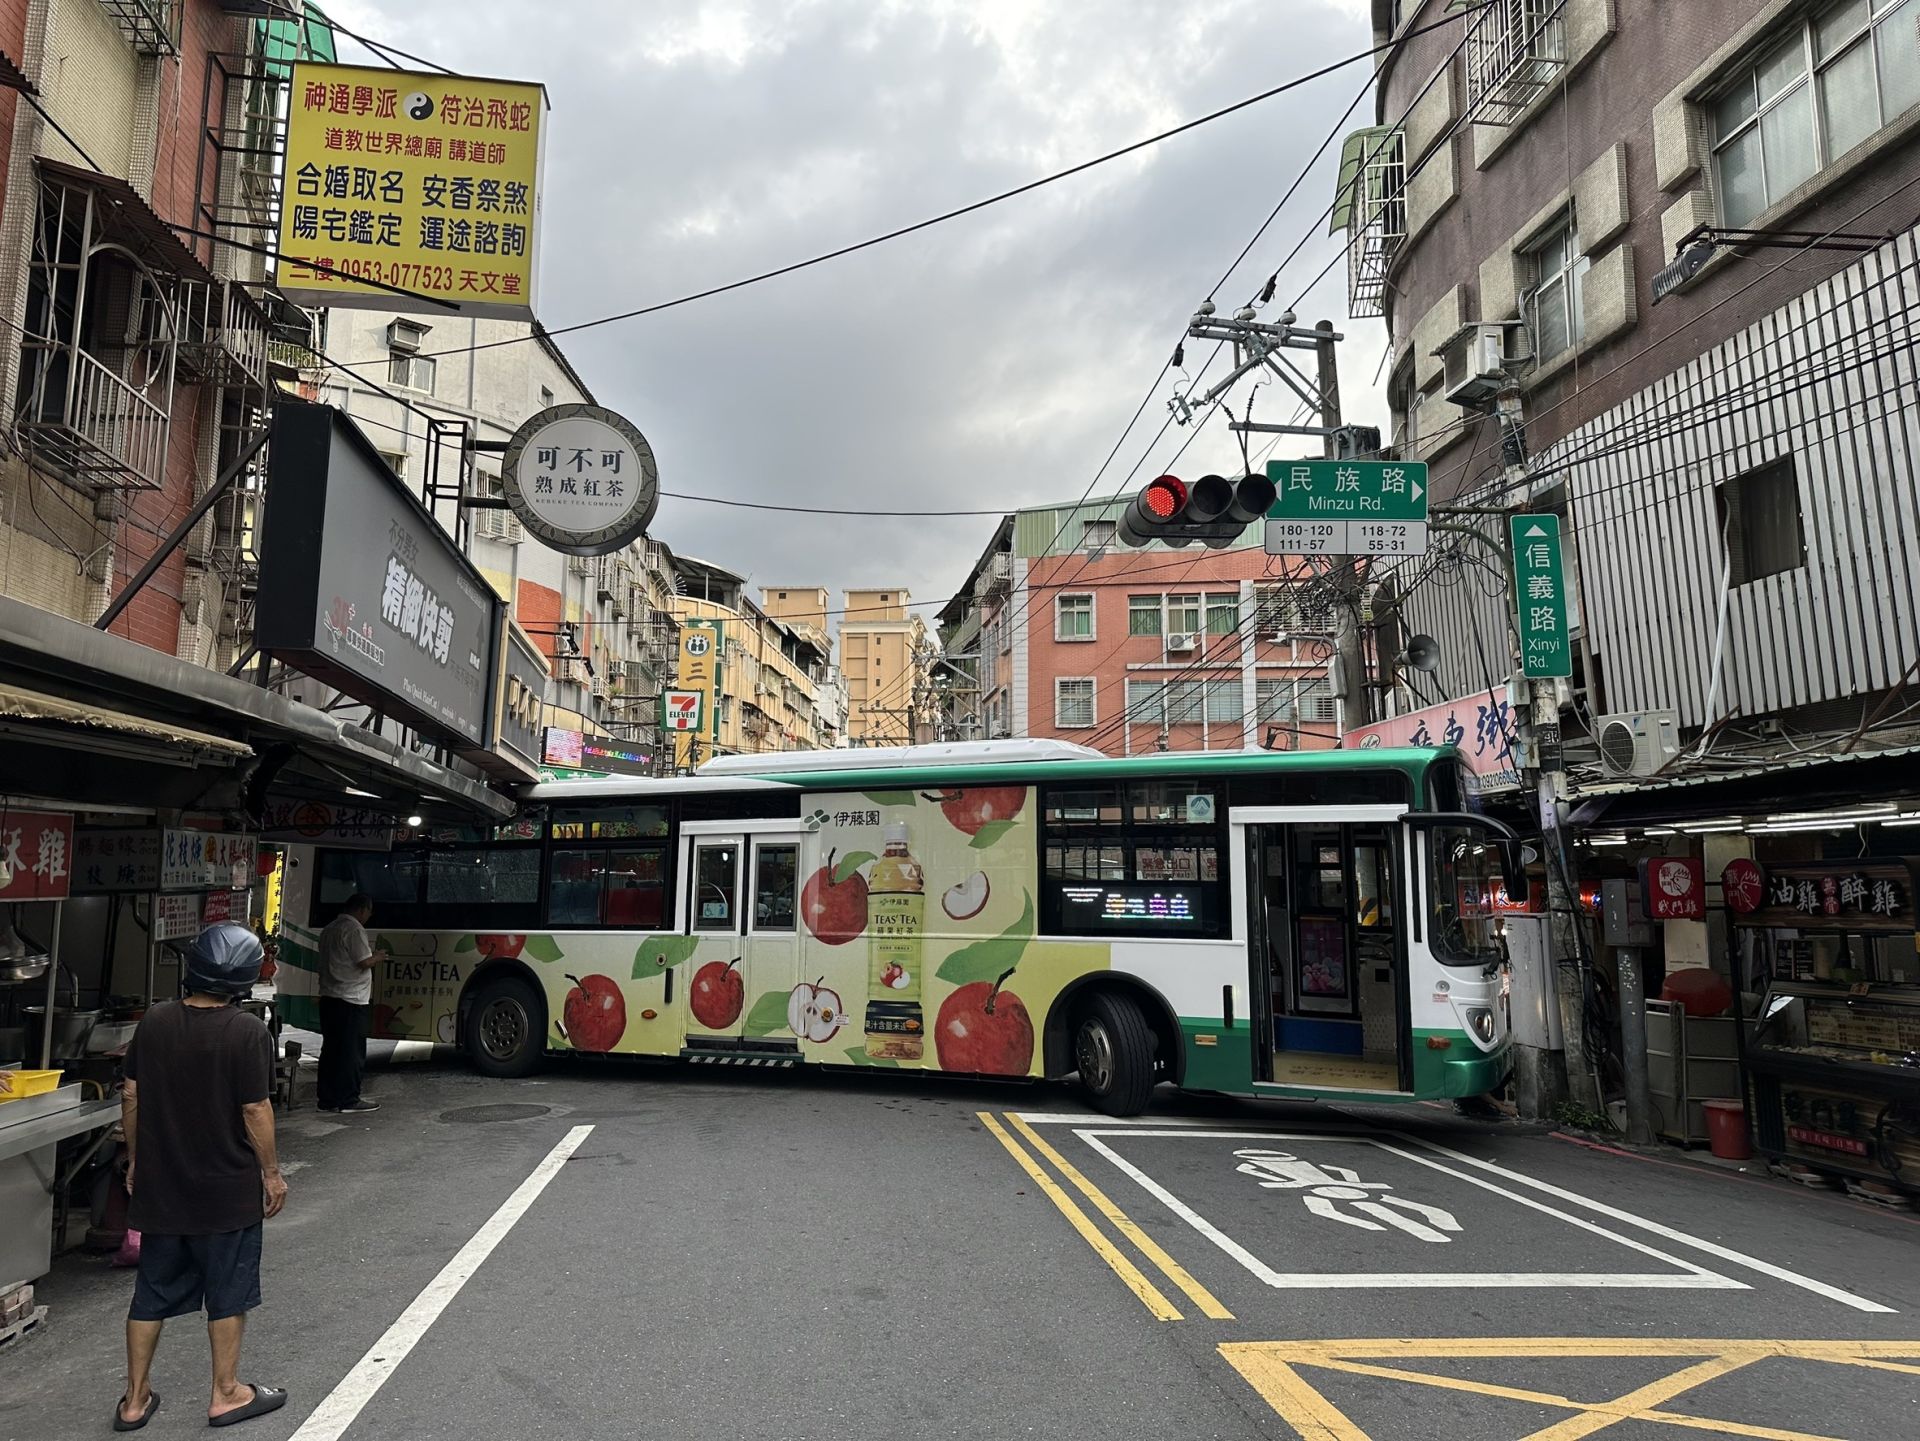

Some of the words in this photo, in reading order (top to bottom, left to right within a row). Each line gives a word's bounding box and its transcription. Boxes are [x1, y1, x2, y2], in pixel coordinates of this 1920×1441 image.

[304, 81, 398, 119] 神通學派
[440, 94, 531, 132] 符治飛蛇
[324, 127, 442, 159] 道教世界總廟
[449, 138, 506, 165] 講道師
[296, 162, 404, 204] 合婚取名
[421, 174, 528, 215] 安香祭煞
[292, 205, 402, 247] 陽宅鑑定
[419, 216, 526, 257] 運途諮詢
[340, 258, 453, 291] 0953-077523
[458, 269, 521, 296] 天文堂
[536, 446, 625, 475] 可不可
[535, 475, 625, 498] 熟成紅茶
[1288, 466, 1406, 494] 民族路
[1308, 496, 1354, 511] Minzu
[1359, 496, 1385, 511] Rd.
[1279, 525, 1334, 537] 180-120
[1361, 526, 1406, 537] 118-72
[1279, 539, 1326, 551] 111-57
[1368, 540, 1405, 551] 55-31
[1525, 544, 1556, 632] 信義路
[382, 556, 455, 665] 精緻快剪
[1528, 637, 1560, 654] Xinyi
[1528, 655, 1549, 668] Rd.
[834, 810, 880, 827] 伊藤園
[1769, 876, 1821, 915] 油雞
[1840, 872, 1900, 917] 醉雞
[876, 926, 914, 936] 蘋果紅茶
[900, 914, 917, 925] TEA
[429, 961, 460, 982] TEA
